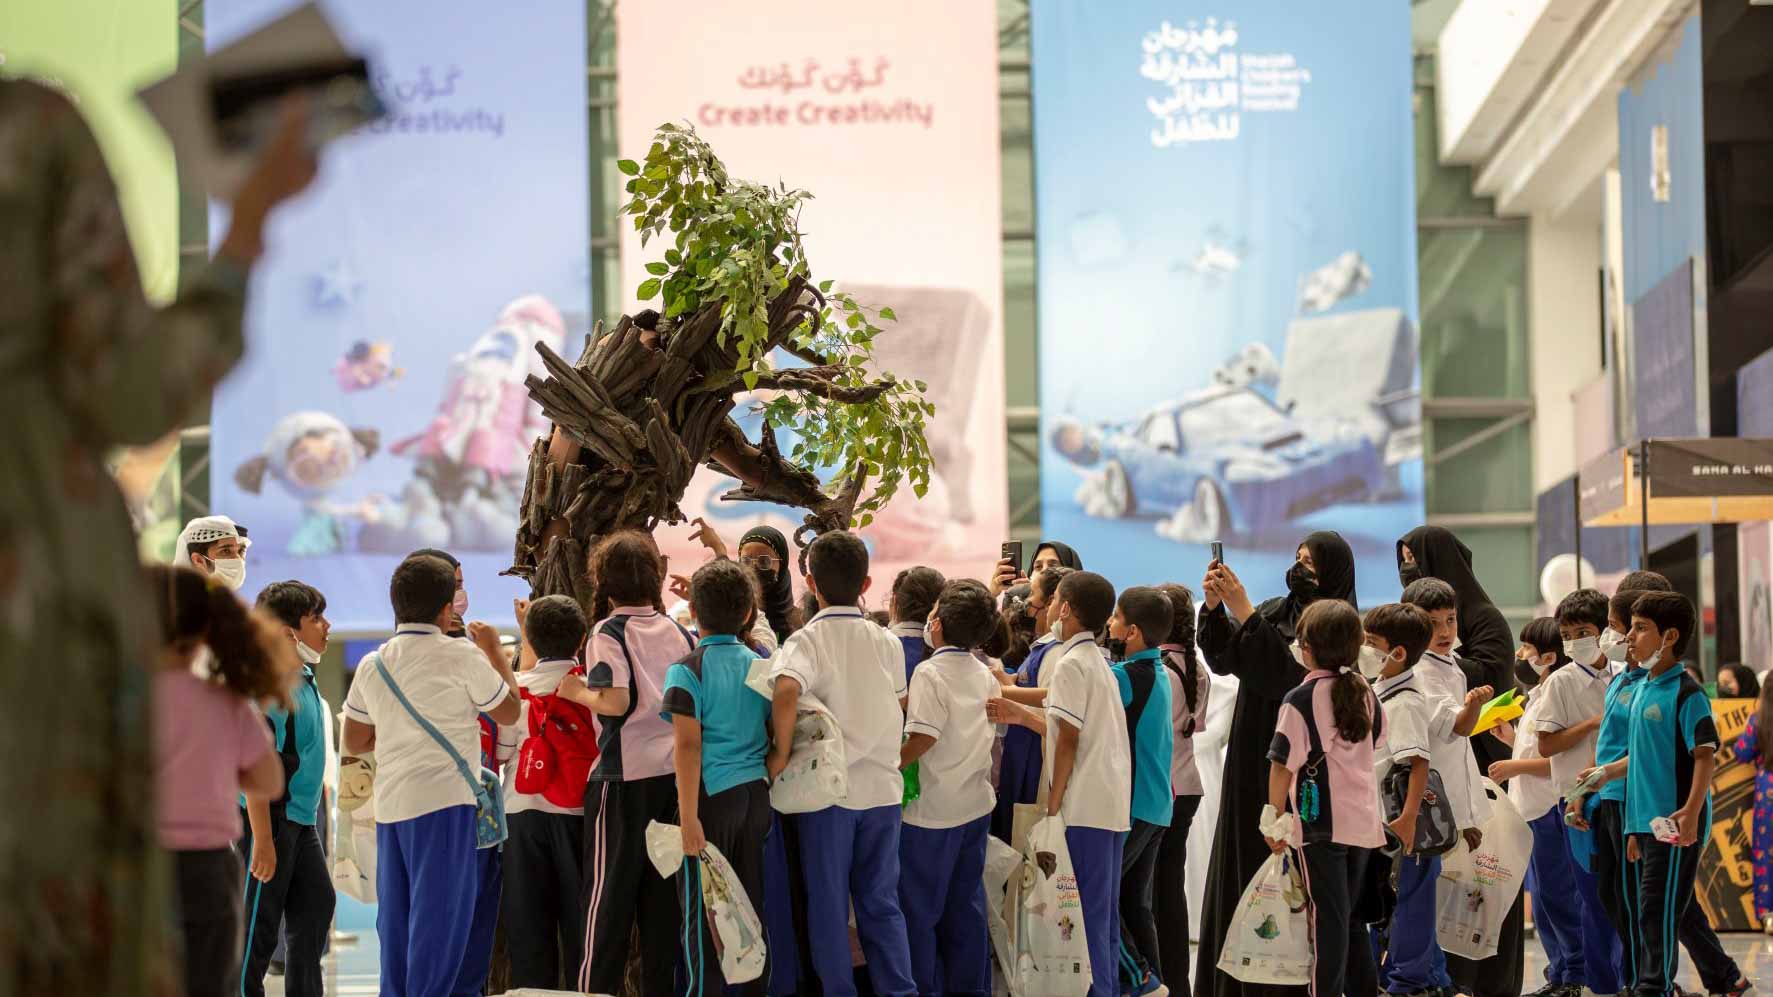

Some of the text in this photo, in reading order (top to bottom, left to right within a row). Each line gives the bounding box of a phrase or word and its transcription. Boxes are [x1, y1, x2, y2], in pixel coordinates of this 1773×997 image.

[698, 100, 934, 129] Create Creativity
[1732, 464, 1751, 475] AL
